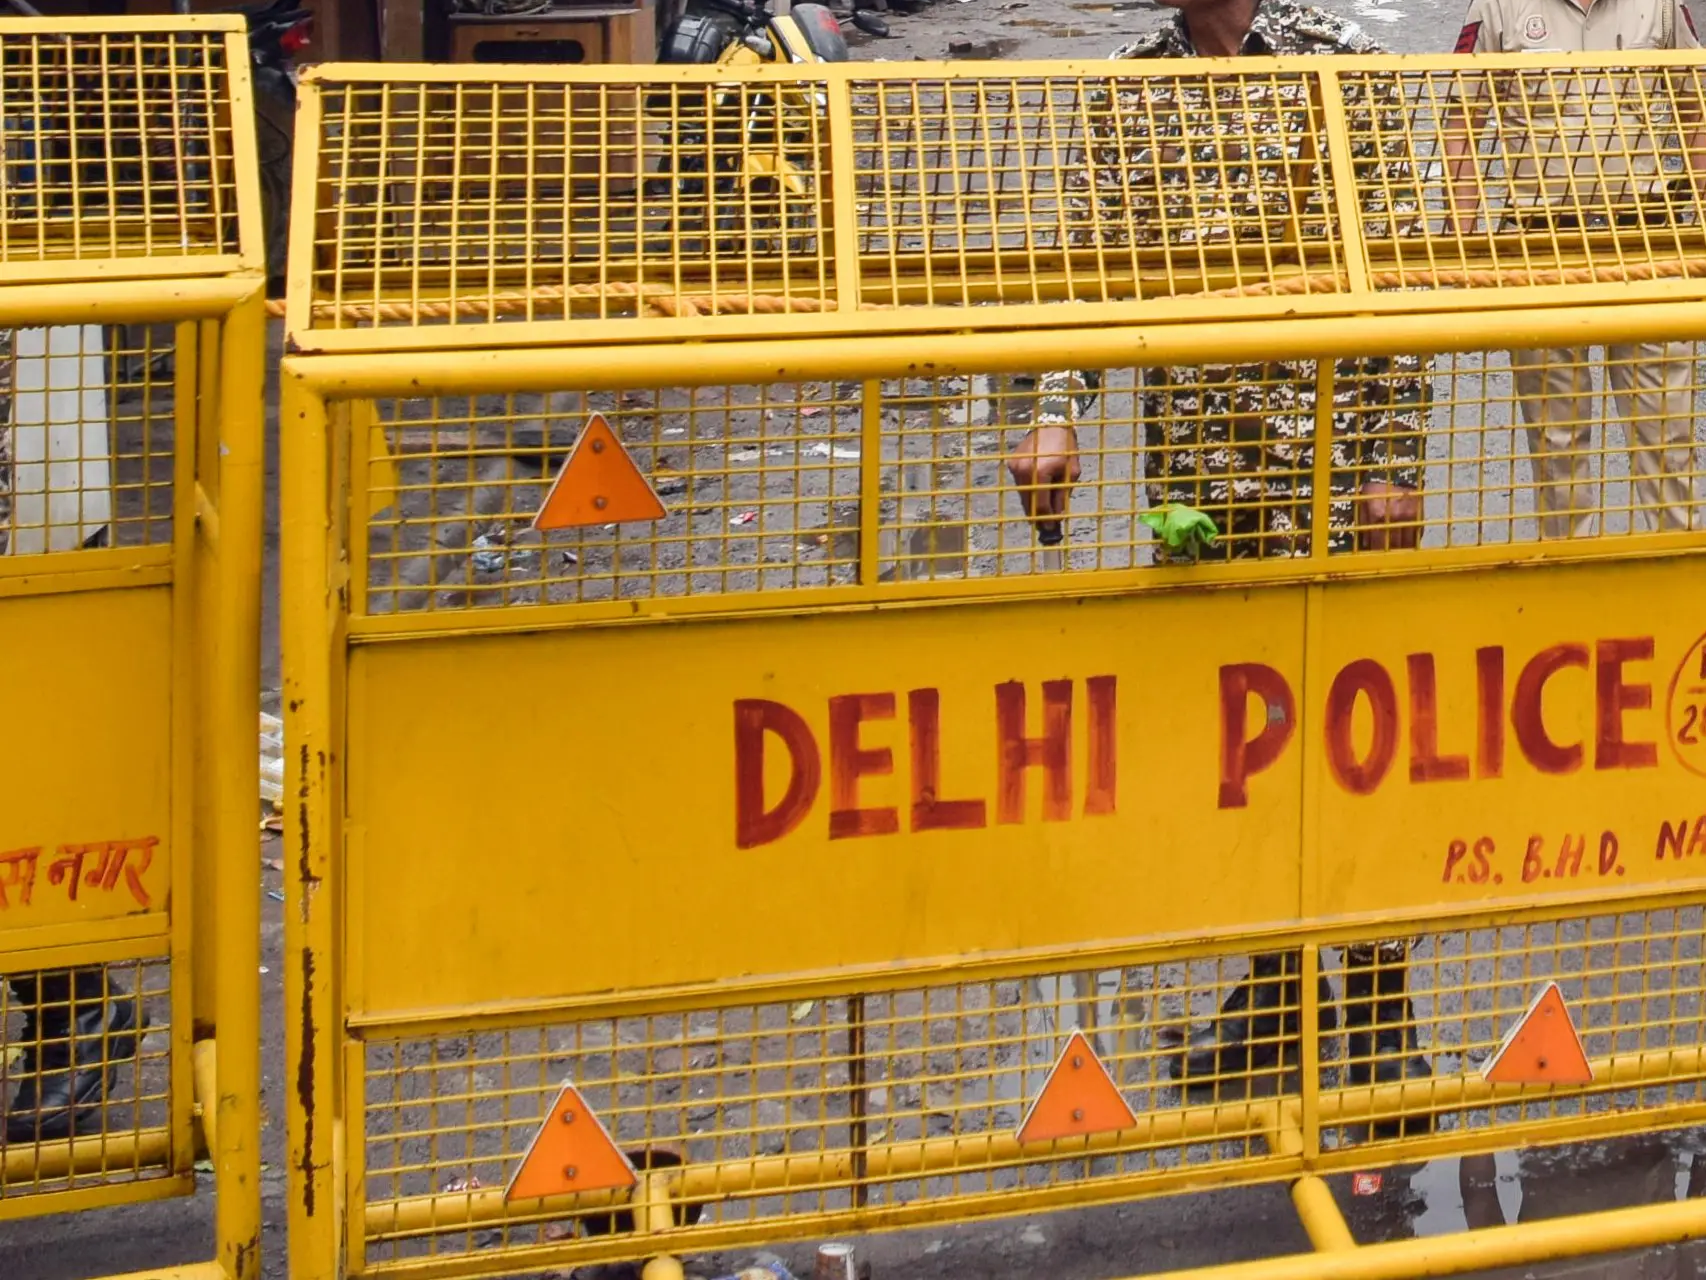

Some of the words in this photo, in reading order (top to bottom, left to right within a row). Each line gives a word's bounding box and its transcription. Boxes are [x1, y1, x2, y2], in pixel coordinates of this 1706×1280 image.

[733, 675, 1118, 850] DELHI
[1217, 635, 1658, 809] POLICE
[47, 834, 161, 908] नगर
[1520, 830, 1626, 884] B.H.D.
